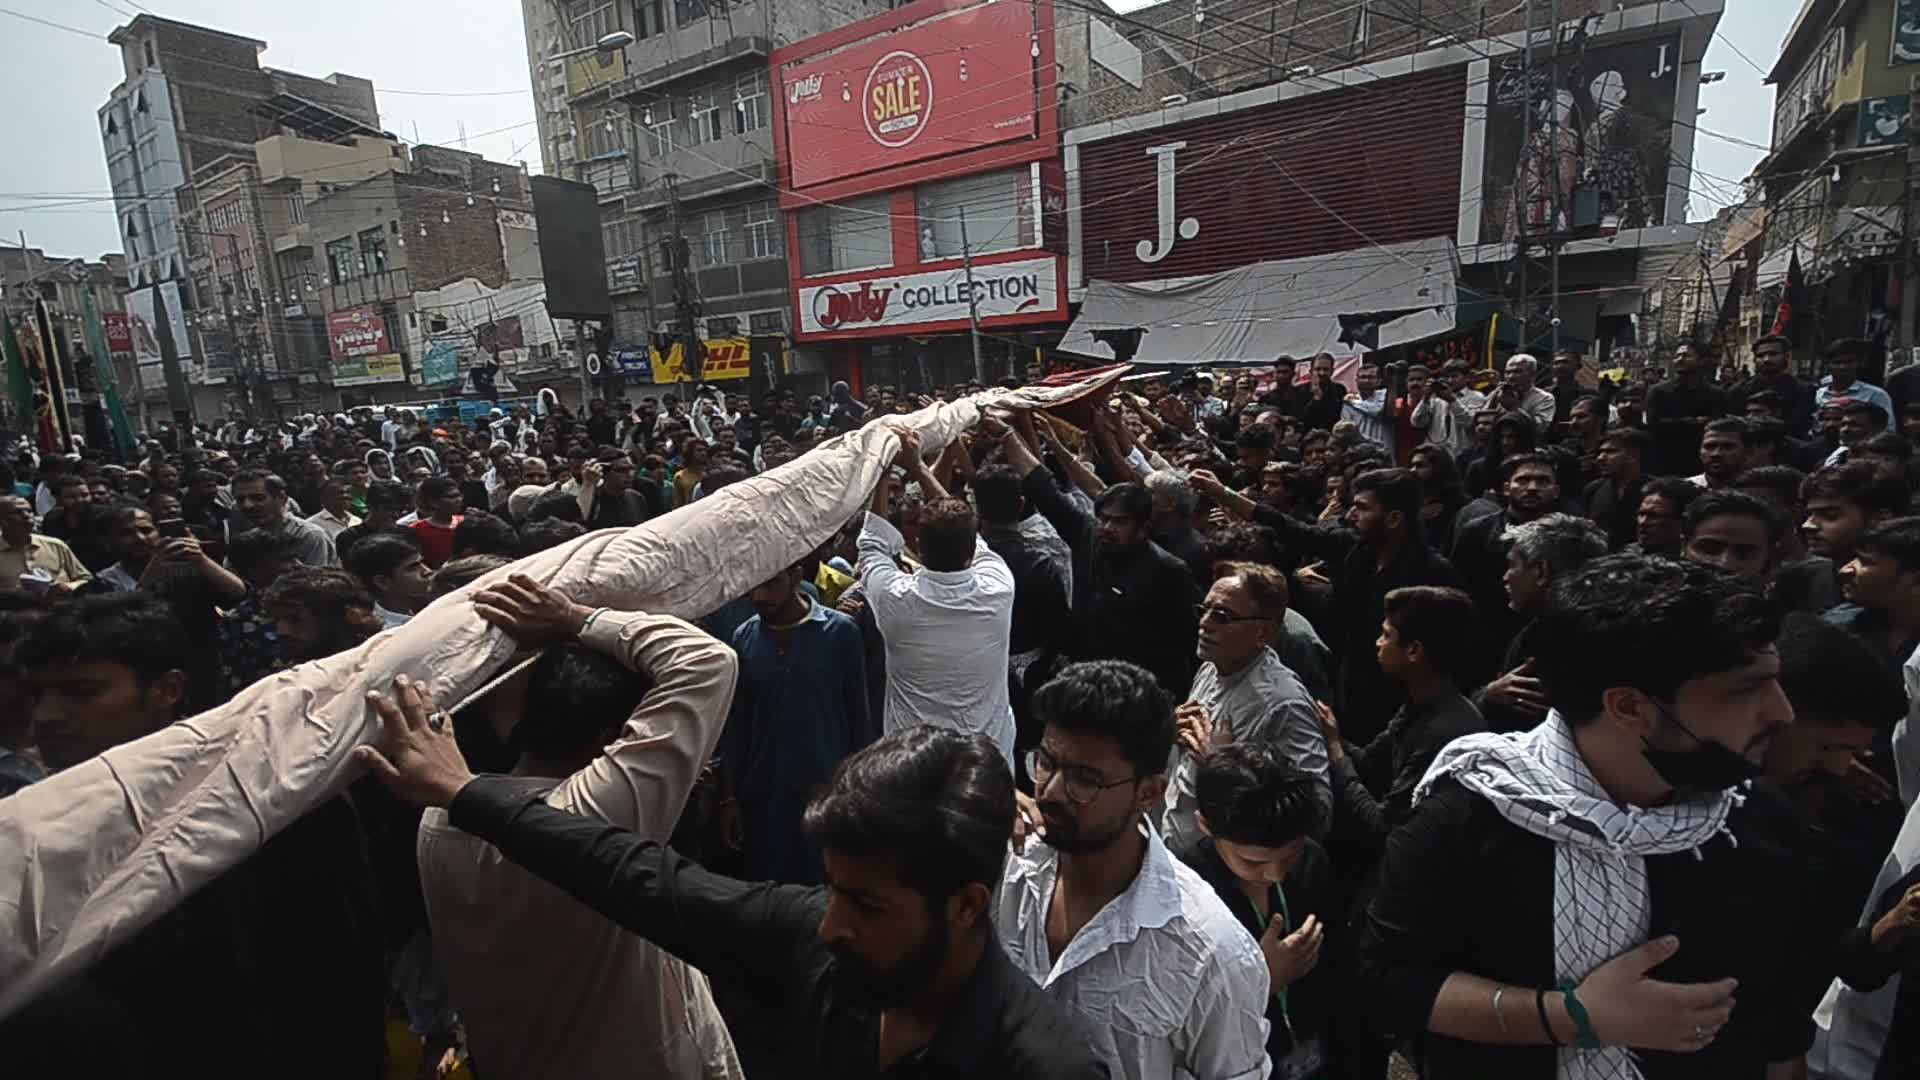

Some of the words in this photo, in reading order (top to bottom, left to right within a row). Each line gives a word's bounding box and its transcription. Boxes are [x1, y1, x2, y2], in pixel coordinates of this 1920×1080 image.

[1651, 43, 1672, 79] J.
[872, 75, 922, 121] SALE
[1136, 141, 1200, 263] J.
[902, 275, 1038, 308] COLLECTION
[692, 345, 751, 371] HL
